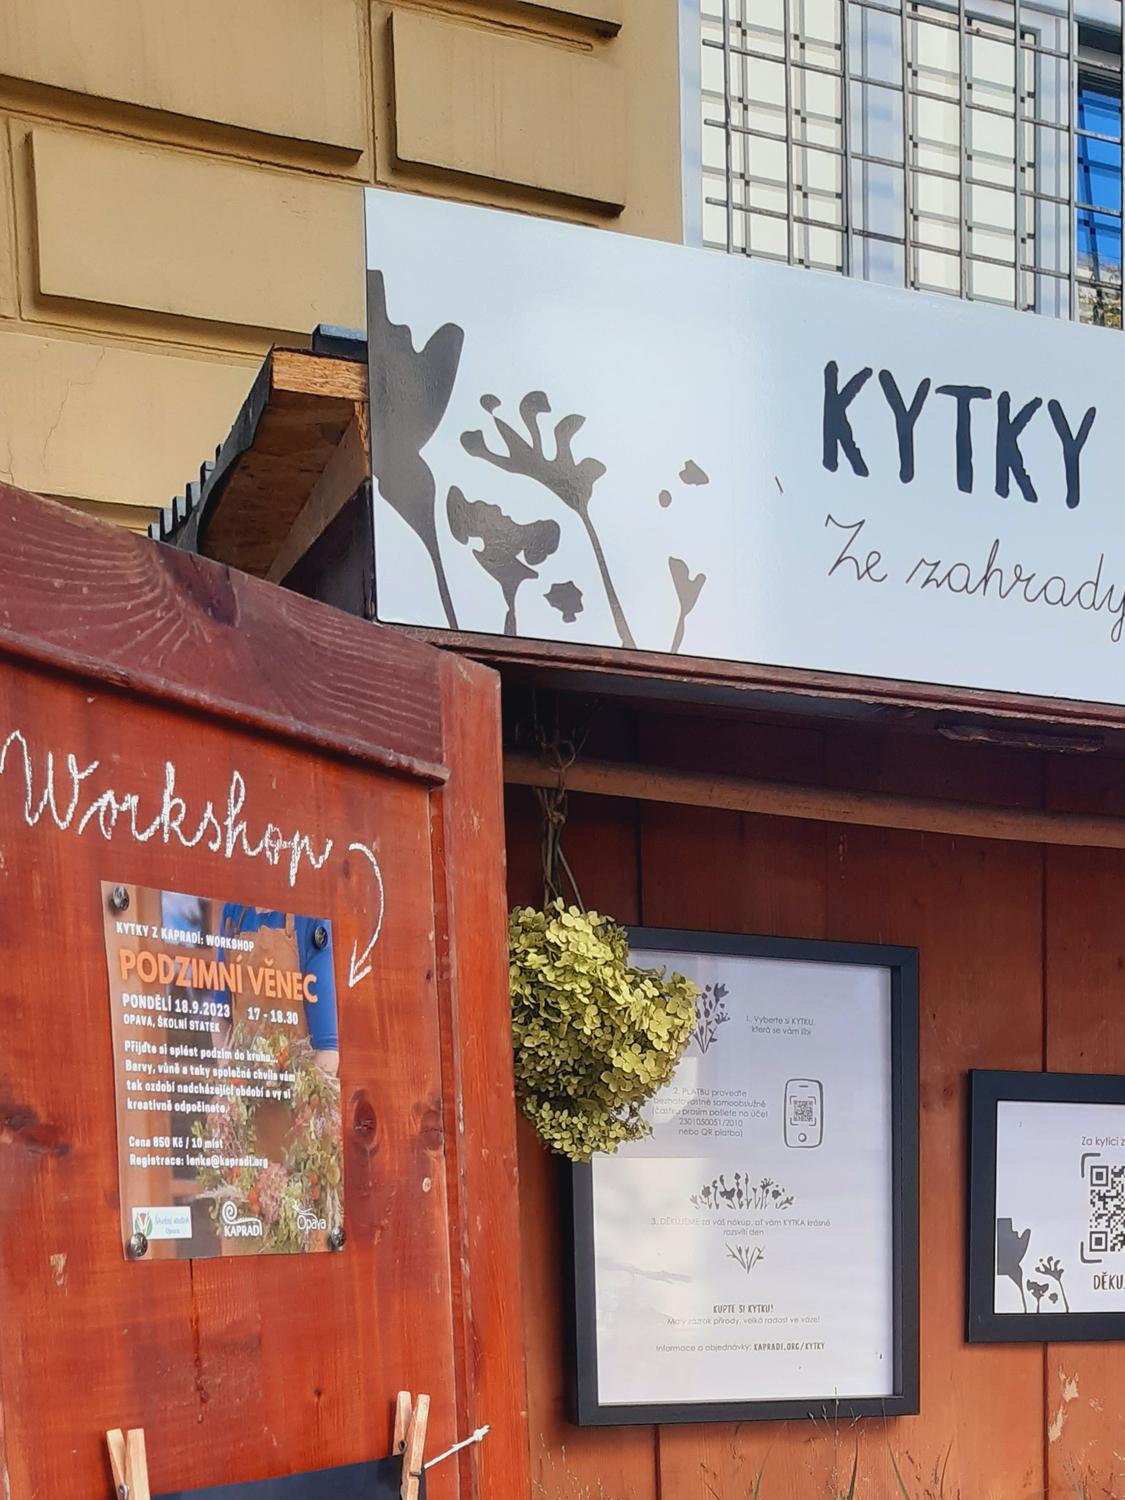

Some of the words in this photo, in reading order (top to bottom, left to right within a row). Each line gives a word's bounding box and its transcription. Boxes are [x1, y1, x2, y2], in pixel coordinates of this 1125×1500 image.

[822, 360, 1096, 508] KYTKY
[825, 513, 888, 582] Ze
[0, 729, 334, 887] Workshop
[116, 921, 149, 939] KYTKY
[151, 927, 159, 939] Z
[161, 928, 204, 946] KAPRADÍ:
[206, 935, 255, 953] WORKSHOP
[119, 948, 243, 994] PODZIMNÍ
[247, 956, 319, 1004] VĚNEC
[122, 991, 171, 1012] PONDĚLÍ
[174, 998, 231, 1019] 18.9.2023
[247, 1006, 260, 1021] 17
[270, 1008, 299, 1026] 18.30
[123, 1013, 156, 1028] OPAVA,
[157, 1014, 188, 1030] ŠKOLNÍ
[189, 1018, 220, 1033] STATEK
[124, 1040, 157, 1055] Přijďte
[159, 1043, 168, 1055] si
[169, 1044, 198, 1058] splést
[200, 1046, 232, 1060] podzim
[234, 1048, 245, 1061] do
[125, 1059, 156, 1075] Barvy,
[157, 1061, 180, 1074] vůně
[182, 1066, 188, 1075] a
[189, 1065, 210, 1079] taky
[279, 1070, 296, 1082] vám
[126, 1079, 143, 1091] tak
[145, 1080, 175, 1093] ozdobí
[177, 1081, 234, 1097] nadcházející
[235, 1084, 264, 1098] období
[265, 1089, 271, 1098] a
[272, 1091, 282, 1101] vy
[283, 1088, 292, 1099] si
[127, 1097, 172, 1112] kreativně
[128, 1136, 151, 1149] Cena
[152, 1136, 171, 1149] 850
[172, 1135, 184, 1149] Kč
[191, 1136, 203, 1149] 10
[204, 1136, 224, 1149] míst
[1081, 1136, 1093, 1146] Za
[1095, 1136, 1119, 1148] kytici
[129, 1153, 184, 1168] Registrace:
[296, 1214, 328, 1234] Opava
[713, 1304, 736, 1314] KUPTE
[738, 1304, 746, 1314] SI
[747, 1303, 775, 1314] KYTKU!
